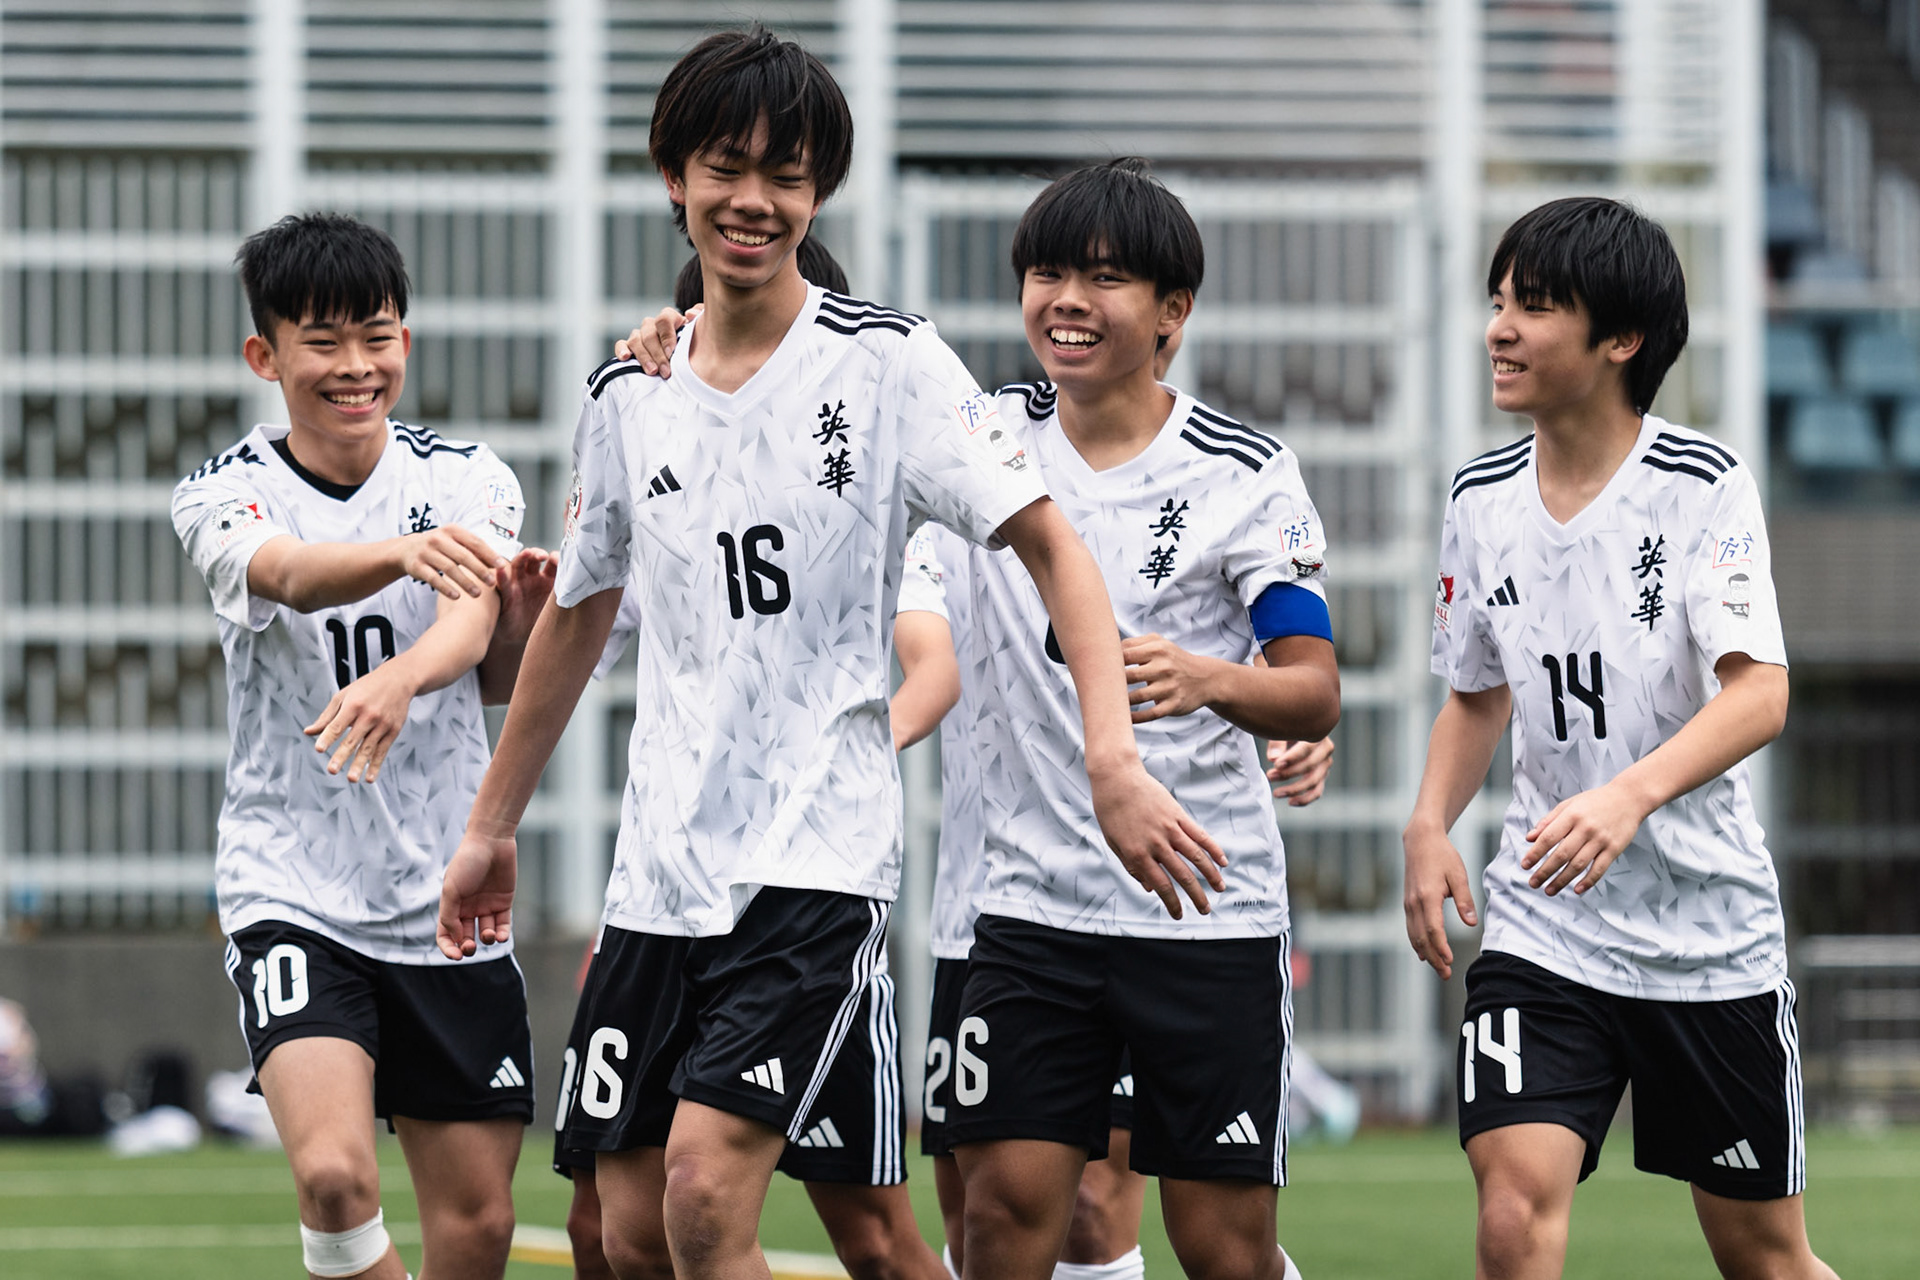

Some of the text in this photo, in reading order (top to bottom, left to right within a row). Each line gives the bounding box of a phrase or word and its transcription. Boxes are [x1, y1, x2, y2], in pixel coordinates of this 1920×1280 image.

[812, 399, 856, 498] 英華
[716, 523, 791, 620] 16
[1138, 498, 1190, 590] 英華
[1630, 534, 1668, 631] 英華
[1541, 650, 1607, 742] 14
[251, 943, 310, 1029] 10
[955, 1015, 990, 1107] 6
[1461, 1006, 1524, 1104] 14
